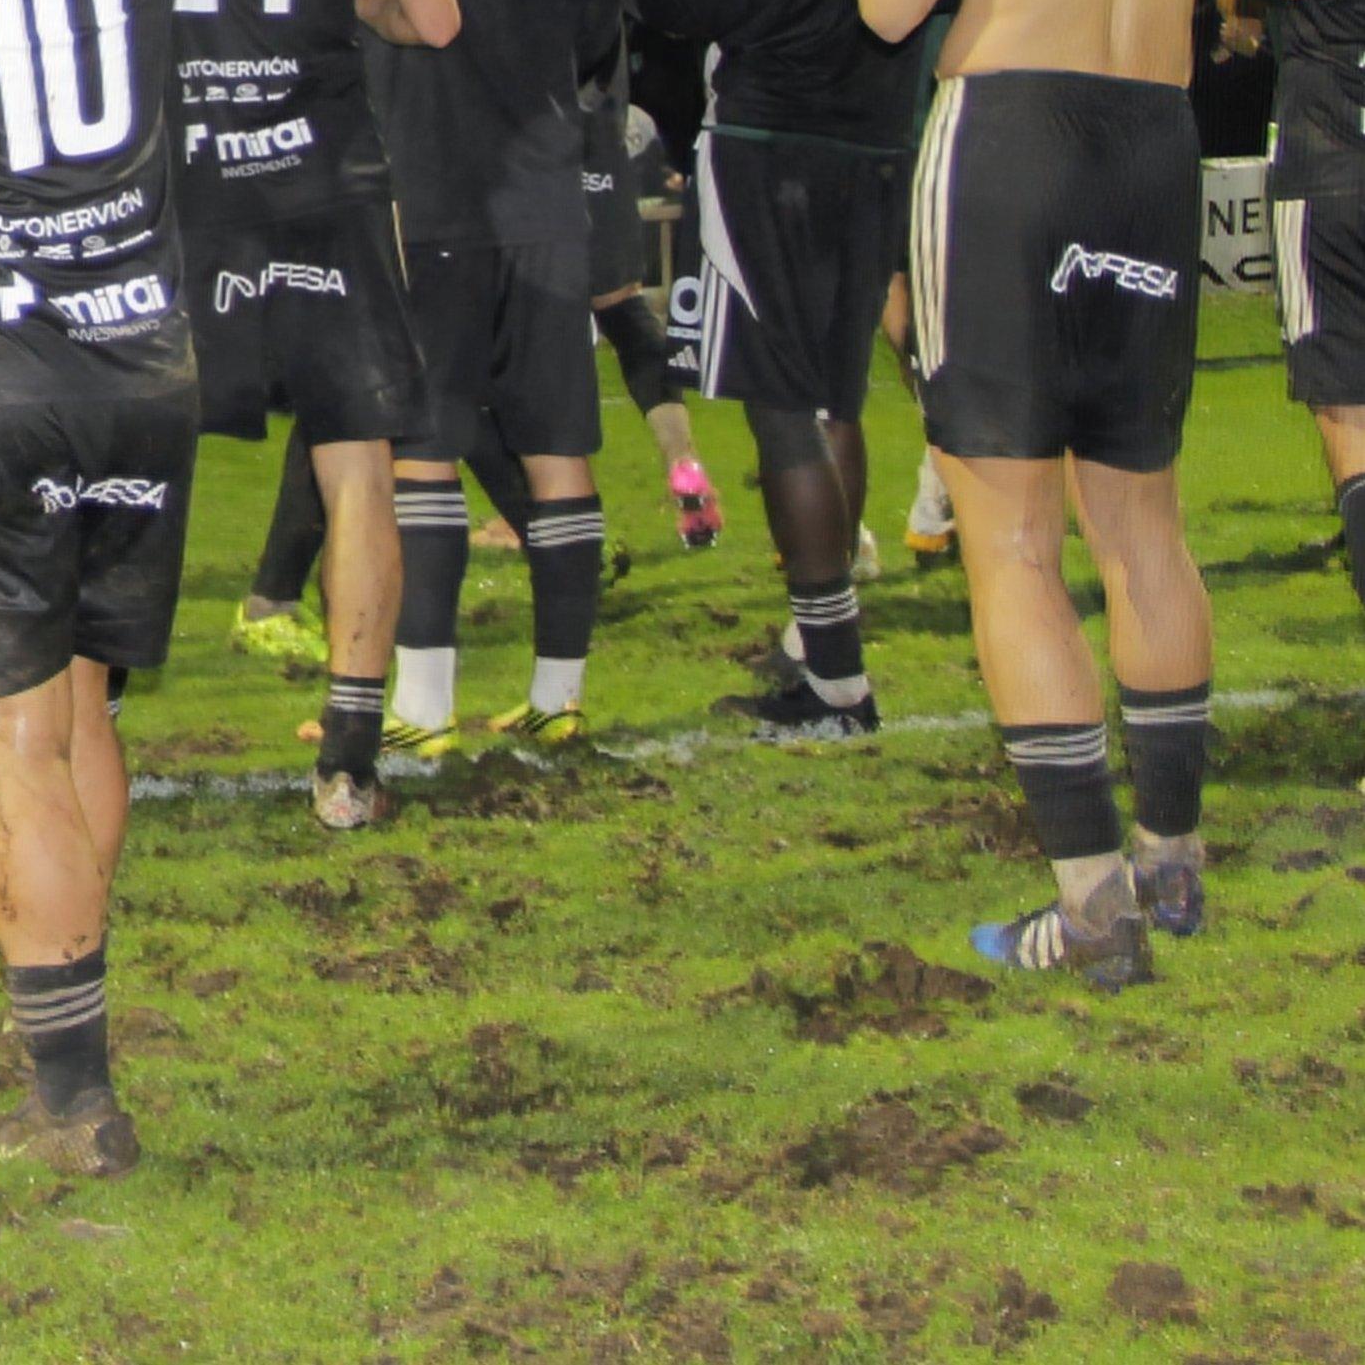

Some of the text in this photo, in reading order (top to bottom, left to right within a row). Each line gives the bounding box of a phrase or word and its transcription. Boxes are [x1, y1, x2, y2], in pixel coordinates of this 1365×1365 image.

[178, 56, 299, 79] UTONERVIÓN
[215, 116, 313, 162] mirai
[221, 154, 302, 179] INVESTMENTS
[48, 274, 167, 324] mirai
